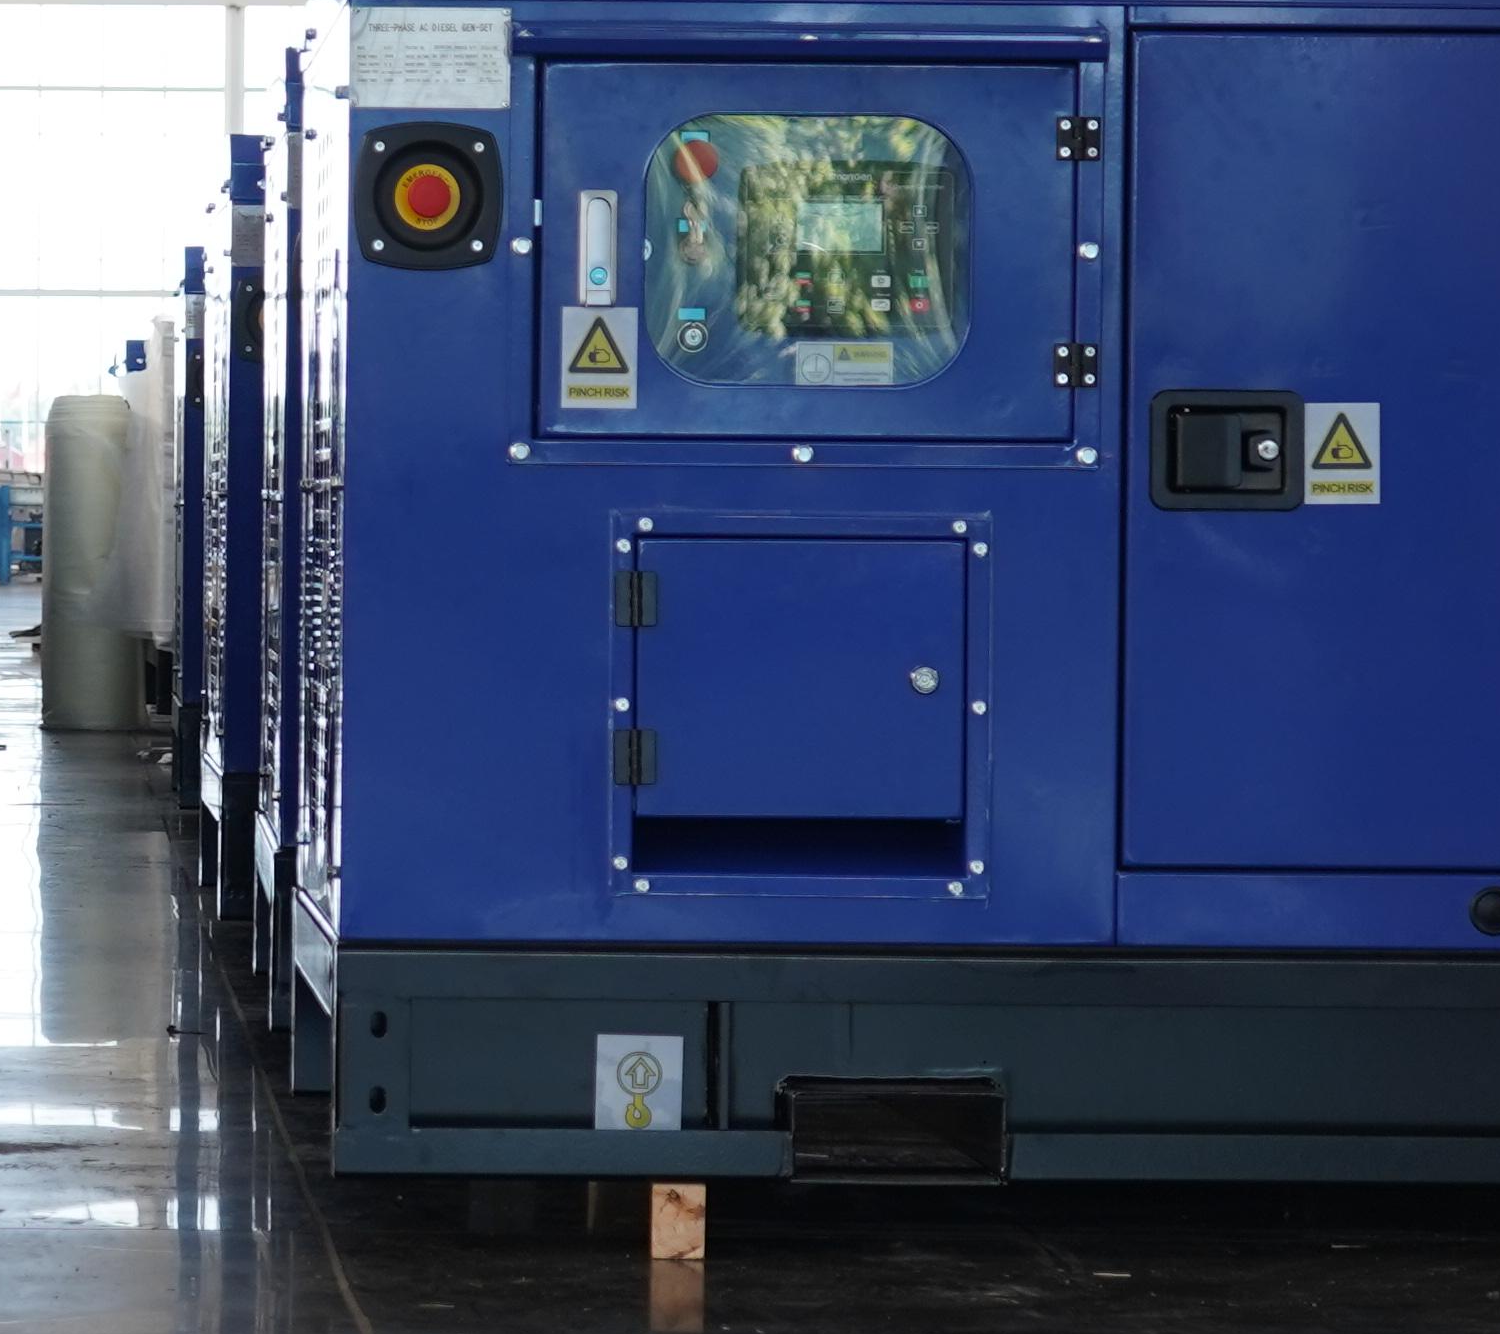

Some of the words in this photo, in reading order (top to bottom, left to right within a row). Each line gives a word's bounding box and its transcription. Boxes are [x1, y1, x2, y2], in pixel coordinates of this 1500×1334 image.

[419, 23, 429, 32] AC
[431, 23, 458, 32] DIESEL
[569, 387, 602, 397] PINCH
[604, 387, 630, 398] RISK
[1312, 484, 1346, 493] PINCH
[1347, 484, 1373, 493] RISK
